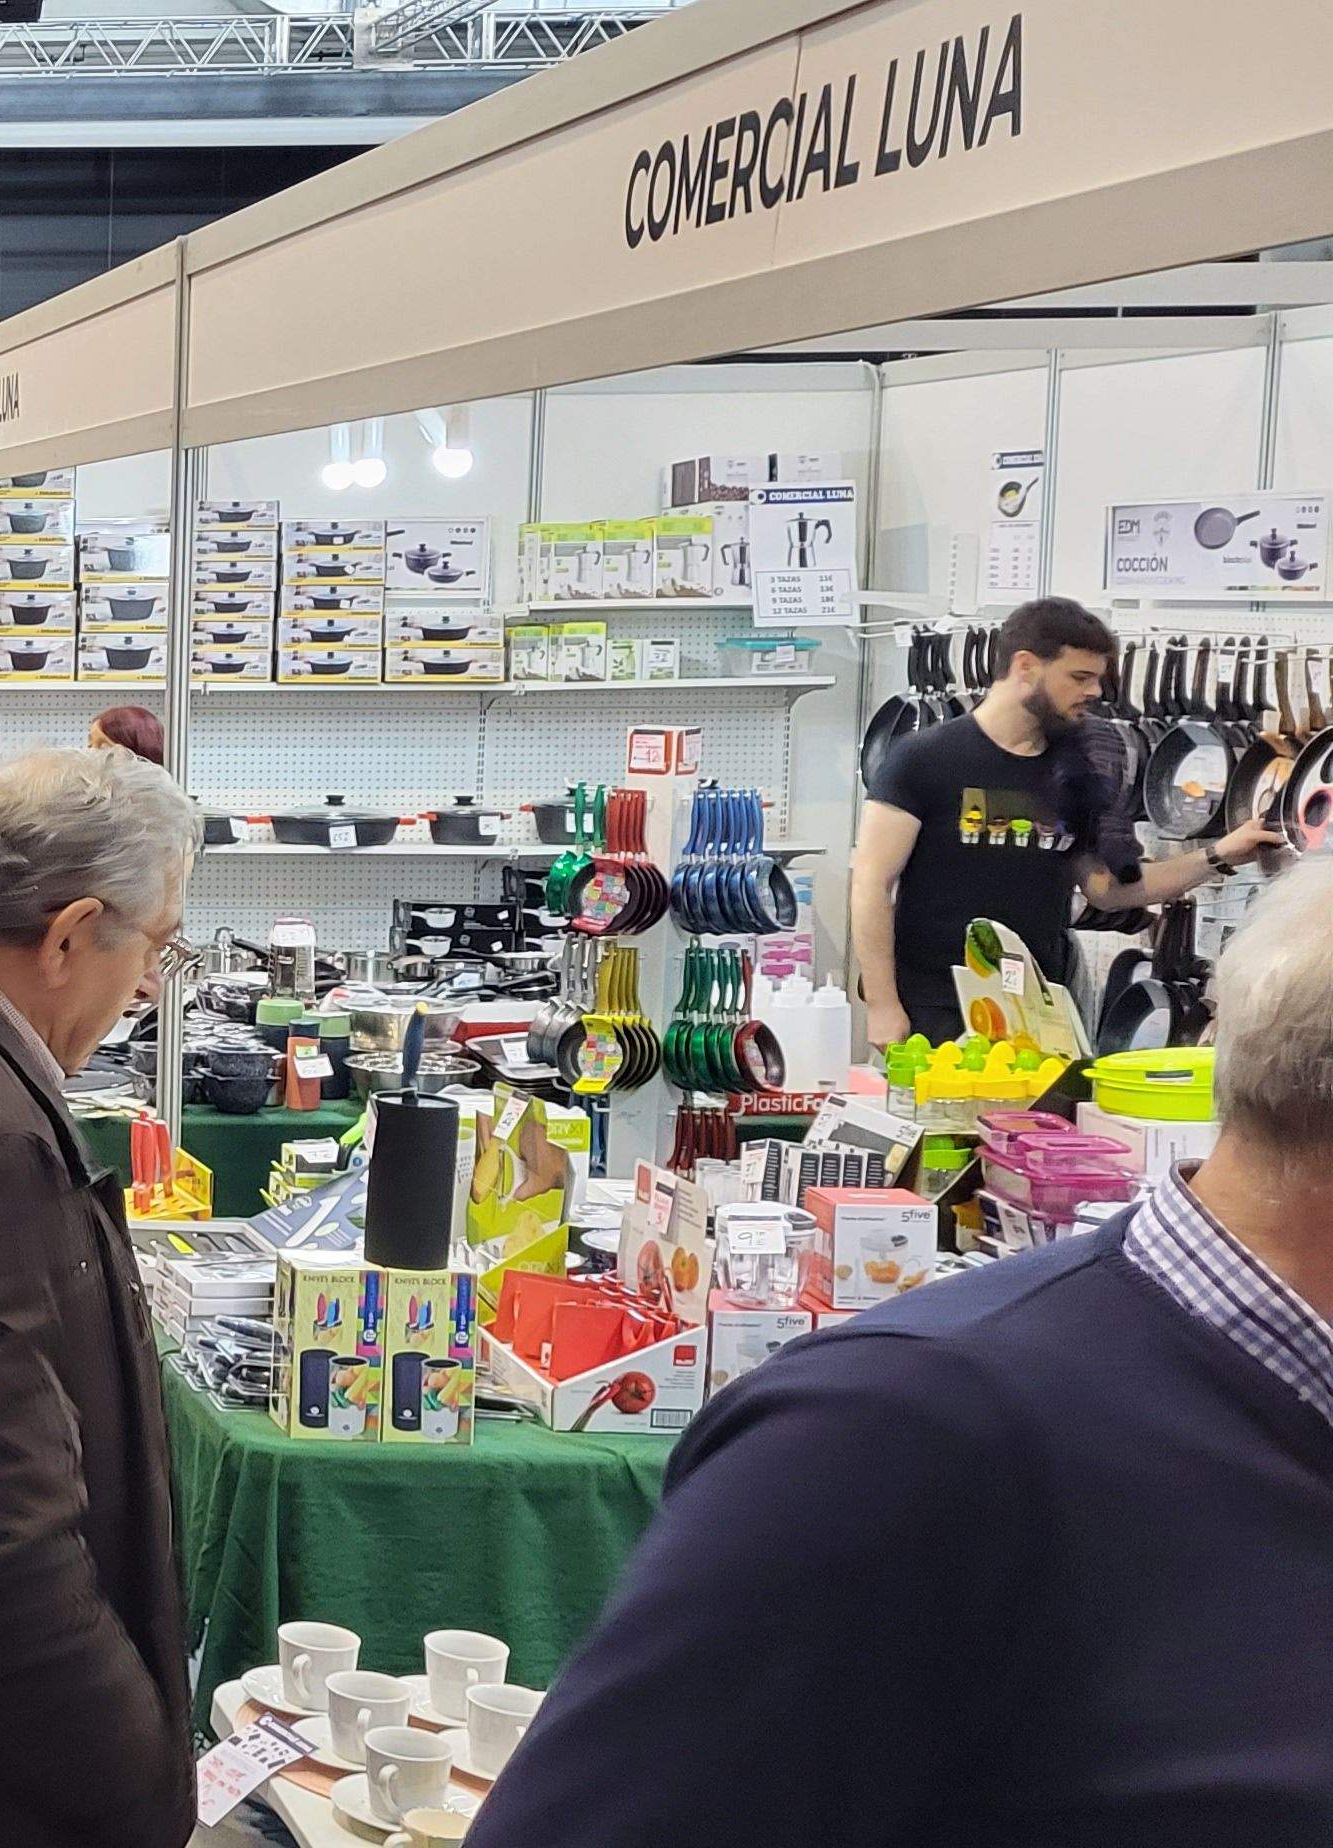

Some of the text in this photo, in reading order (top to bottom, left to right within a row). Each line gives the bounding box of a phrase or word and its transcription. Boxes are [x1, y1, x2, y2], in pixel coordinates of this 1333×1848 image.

[625, 12, 1023, 250] COMERCIAL LUNA
[769, 489, 854, 501] COMERCIAL LUNA
[1117, 553, 1168, 572] COCCIÓN
[900, 1210, 931, 1223] 5five
[776, 1316, 806, 1329] 5five
